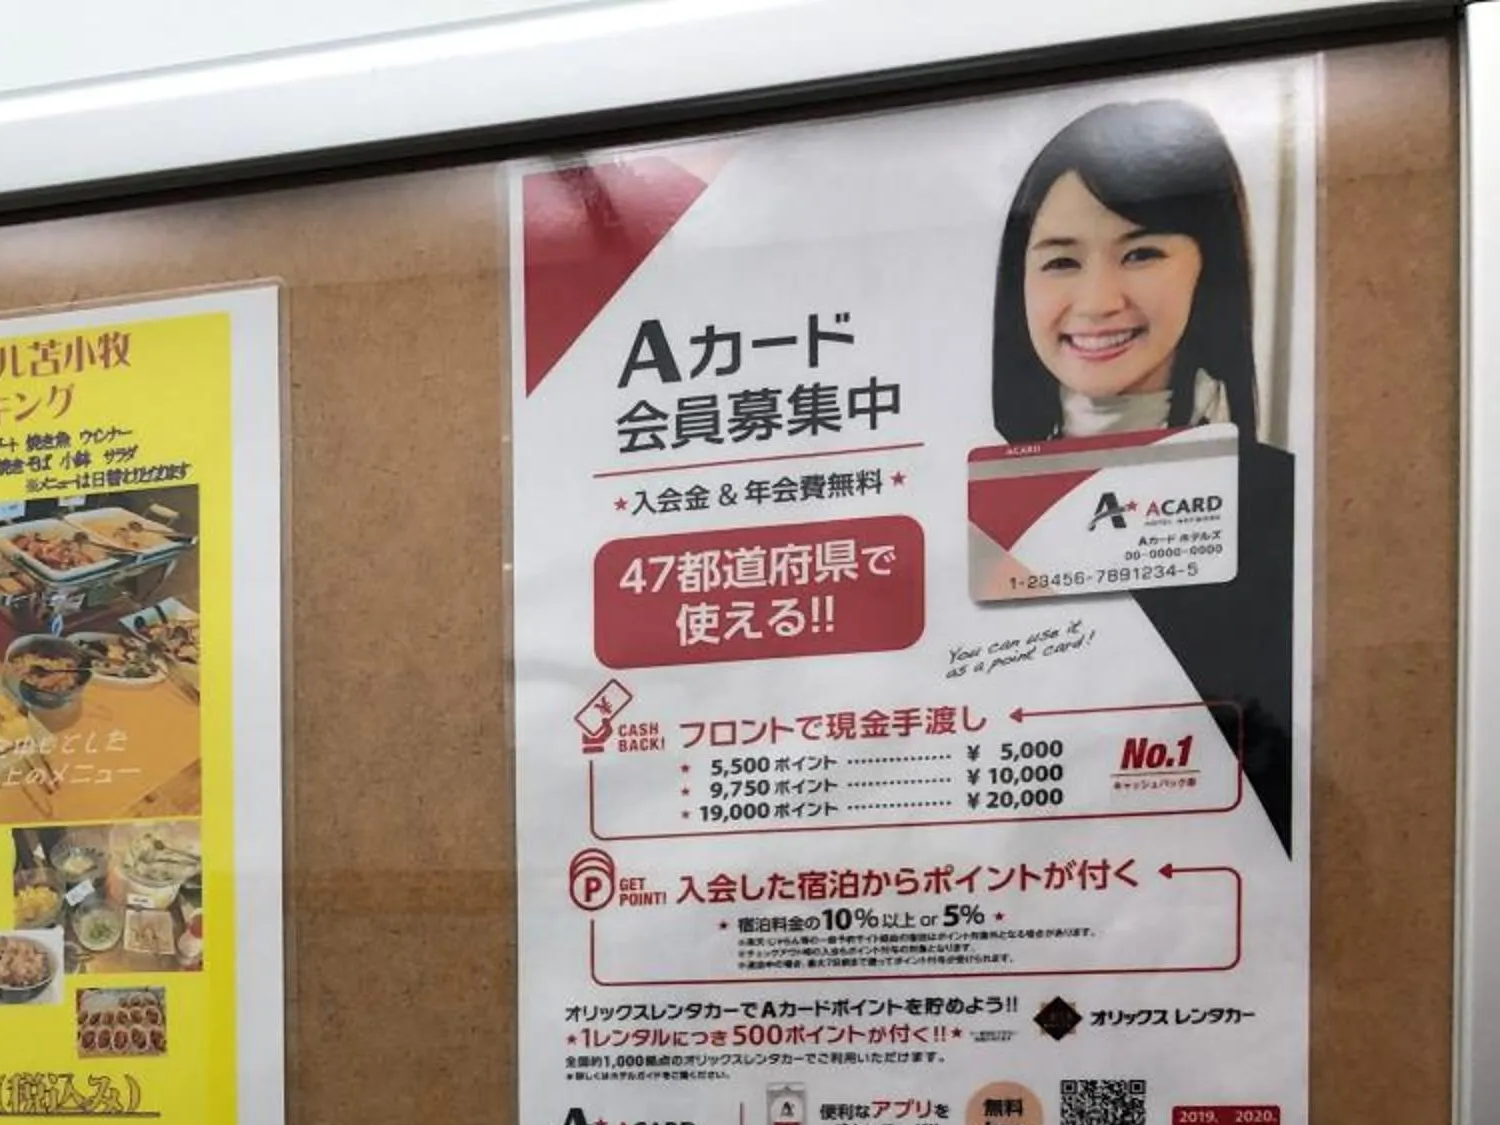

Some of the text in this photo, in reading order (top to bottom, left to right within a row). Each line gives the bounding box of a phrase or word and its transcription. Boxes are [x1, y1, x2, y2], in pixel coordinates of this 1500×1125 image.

[617, 311, 855, 389] Aカード
[616, 376, 901, 454] 会員募集中
[632, 468, 884, 516] 入会金 & 年会費無料
[1145, 495, 1223, 517] ACARD
[619, 538, 897, 595] 47都道府県で
[676, 594, 835, 648] 使える!!
[946, 664, 967, 679] as
[986, 647, 1036, 675] point
[1042, 629, 1096, 657] card!
[948, 644, 981, 665] You
[987, 636, 1020, 653] can
[1026, 628, 1060, 647] use
[618, 721, 660, 738] CASH
[679, 705, 987, 750] フロントで現金手渡し
[618, 737, 666, 754] BACK!
[1120, 735, 1194, 770] No.1
[619, 877, 647, 892] GET
[677, 858, 1139, 905] 入会した宿泊からポイントが付く
[619, 890, 667, 907] POINT!
[943, 904, 986, 928] 5%
[565, 995, 1019, 1023] オリックスレンタカーでAカードポイントを貯めよう!!
[1090, 1007, 1256, 1026] オリックス レンタカー
[819, 1098, 950, 1121] 便利なアプリを
[983, 1098, 1024, 1118] 無料
